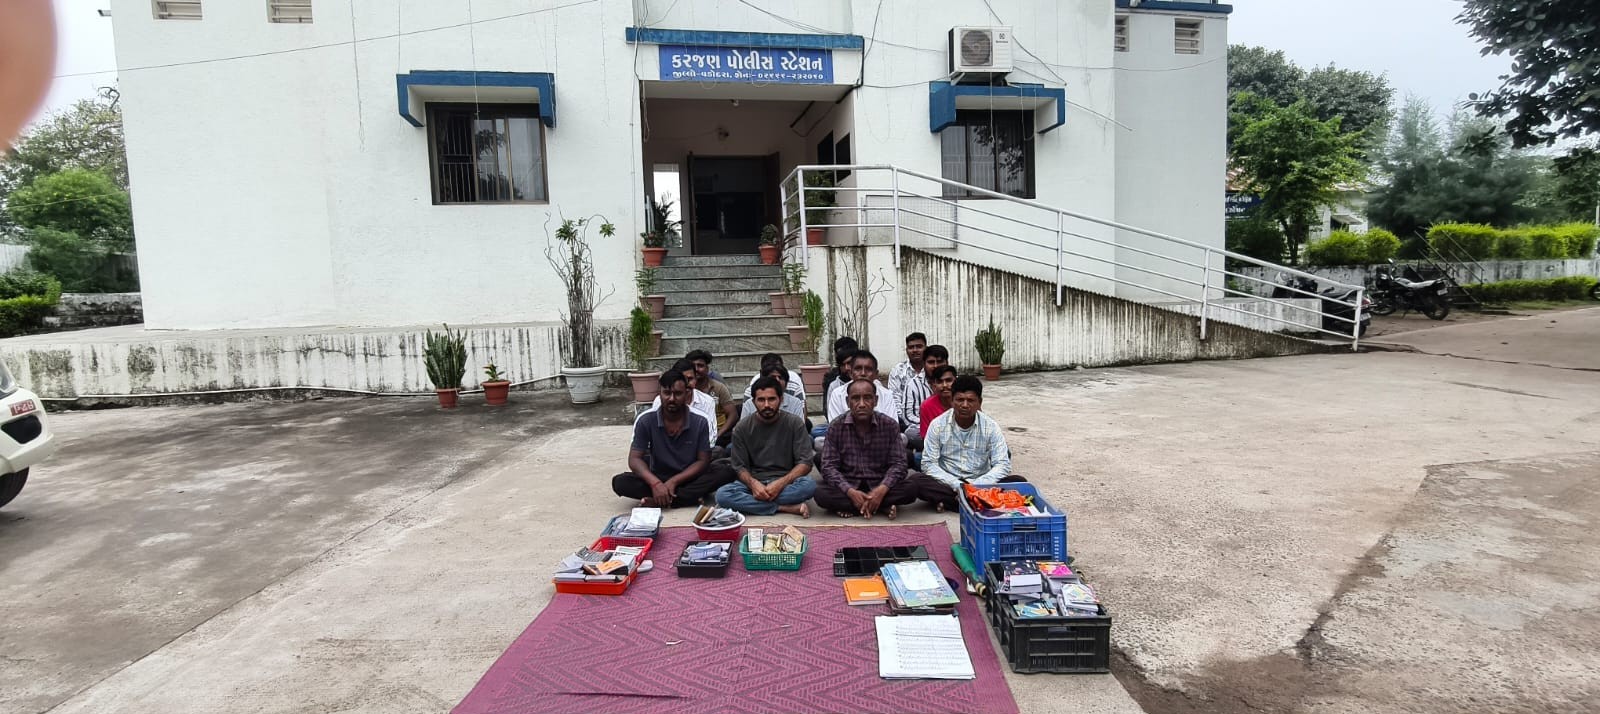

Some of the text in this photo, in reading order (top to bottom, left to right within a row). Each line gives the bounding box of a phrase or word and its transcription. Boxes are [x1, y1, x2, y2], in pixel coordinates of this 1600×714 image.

[672, 49, 823, 71] કરજણ પોલીસ સ્ટેશન
